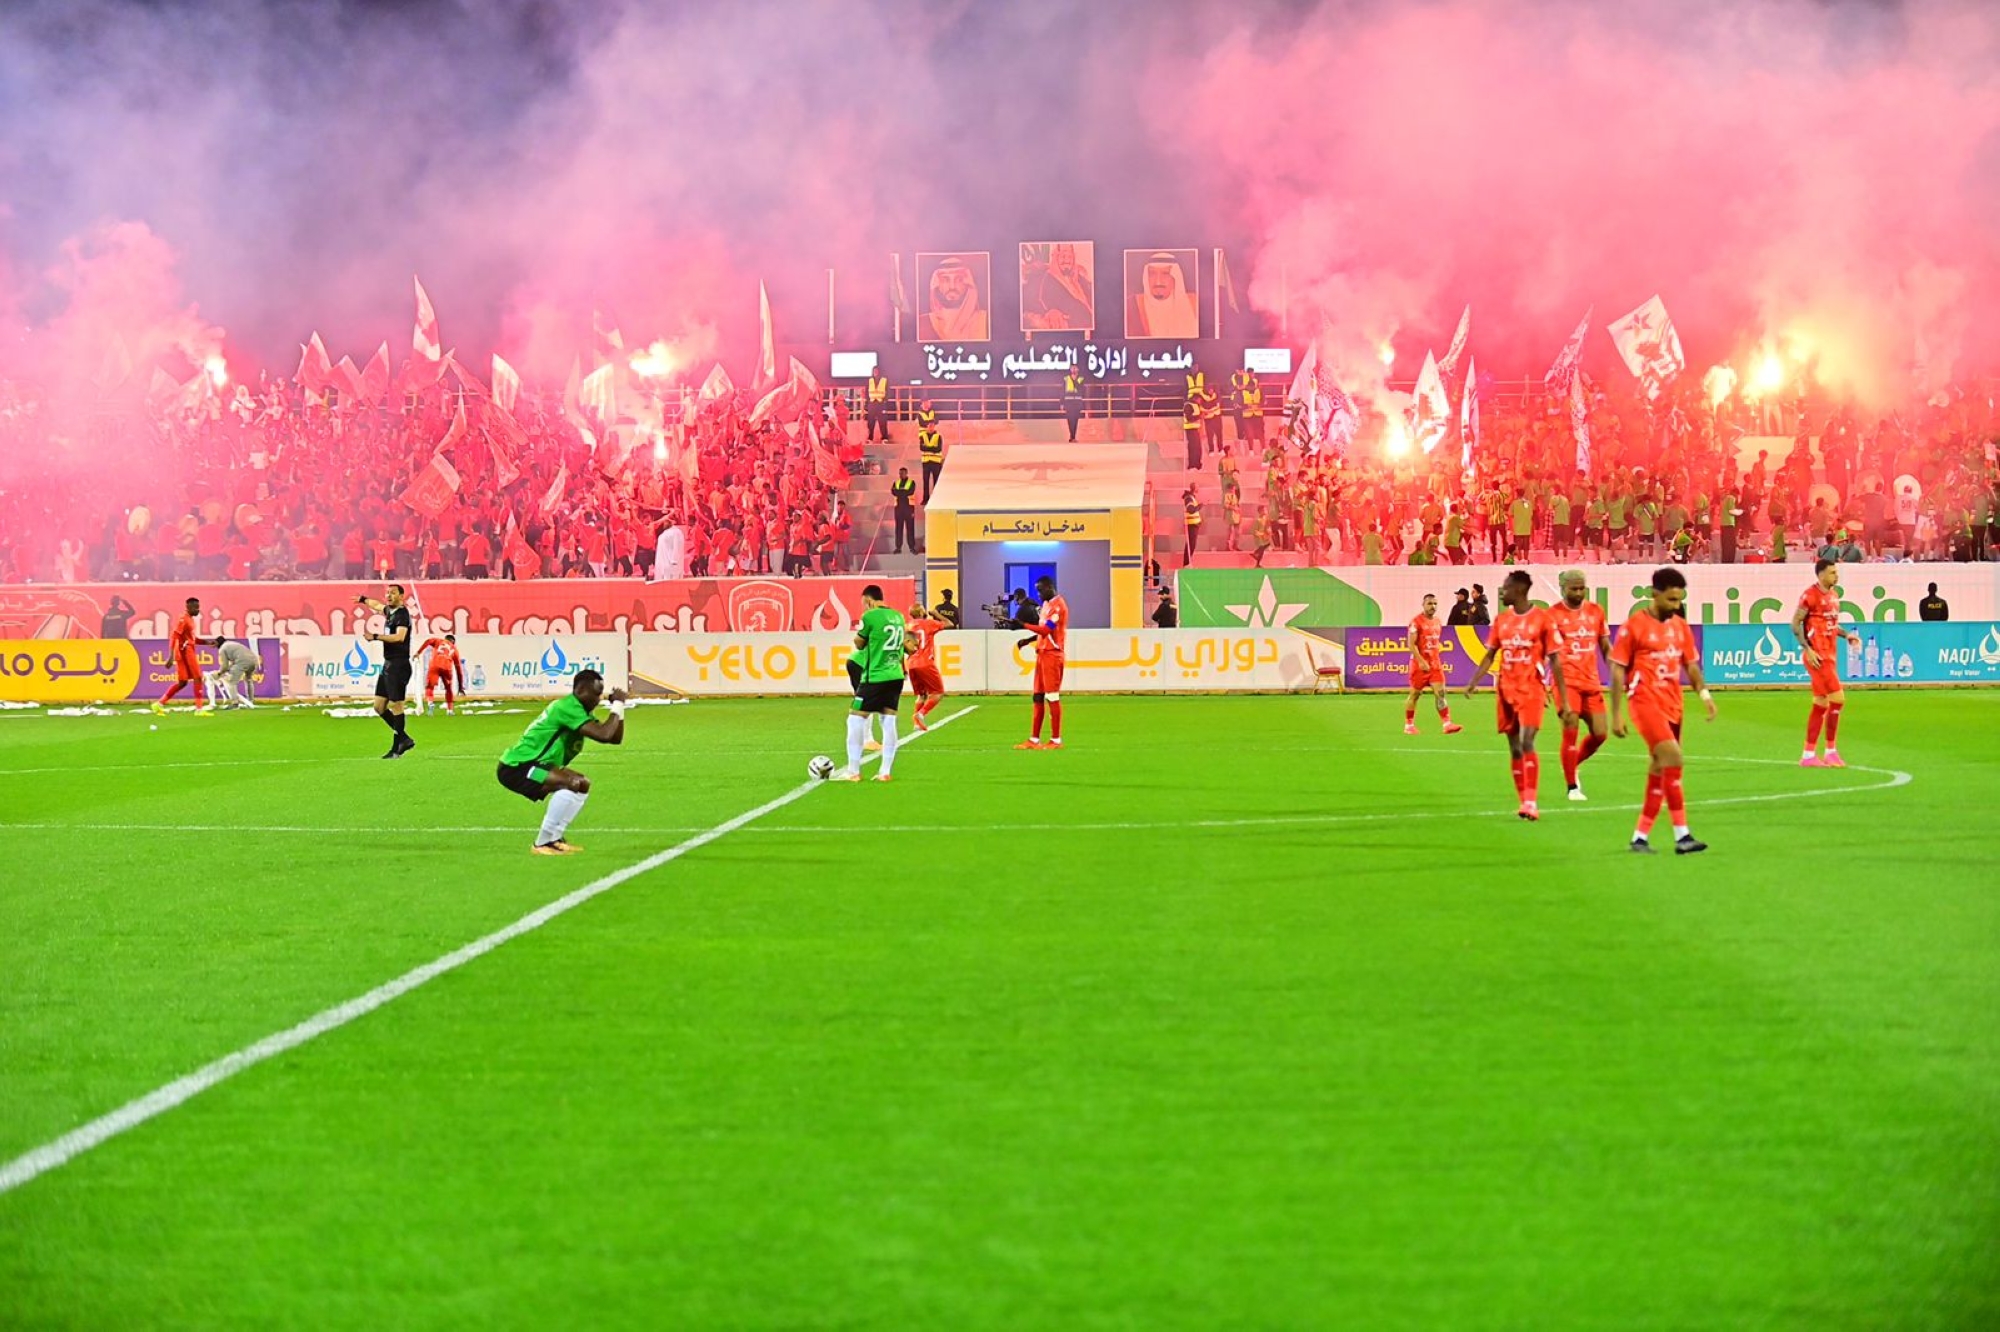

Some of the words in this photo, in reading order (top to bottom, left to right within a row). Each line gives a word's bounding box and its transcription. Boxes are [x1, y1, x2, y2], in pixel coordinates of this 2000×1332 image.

[922, 344, 992, 380] بعنيزة
[1002, 344, 1078, 380] التعليم
[1084, 344, 1127, 378] إدارة
[1137, 345, 1193, 378] ملعب
[983, 519, 1040, 536] الحكام
[1043, 519, 1085, 536] مدخل
[882, 624, 905, 651] 20
[1356, 637, 1411, 656] تطبيق
[43, 651, 119, 683] يلو
[686, 644, 796, 681] YELO
[1175, 638, 1279, 678] دوري
[1354, 662, 1385, 674] الفروع
[1713, 650, 1751, 668] NAQI
[1938, 648, 1977, 666] NAQI
[305, 662, 341, 679] NAQI
[501, 661, 538, 678] NAQI
